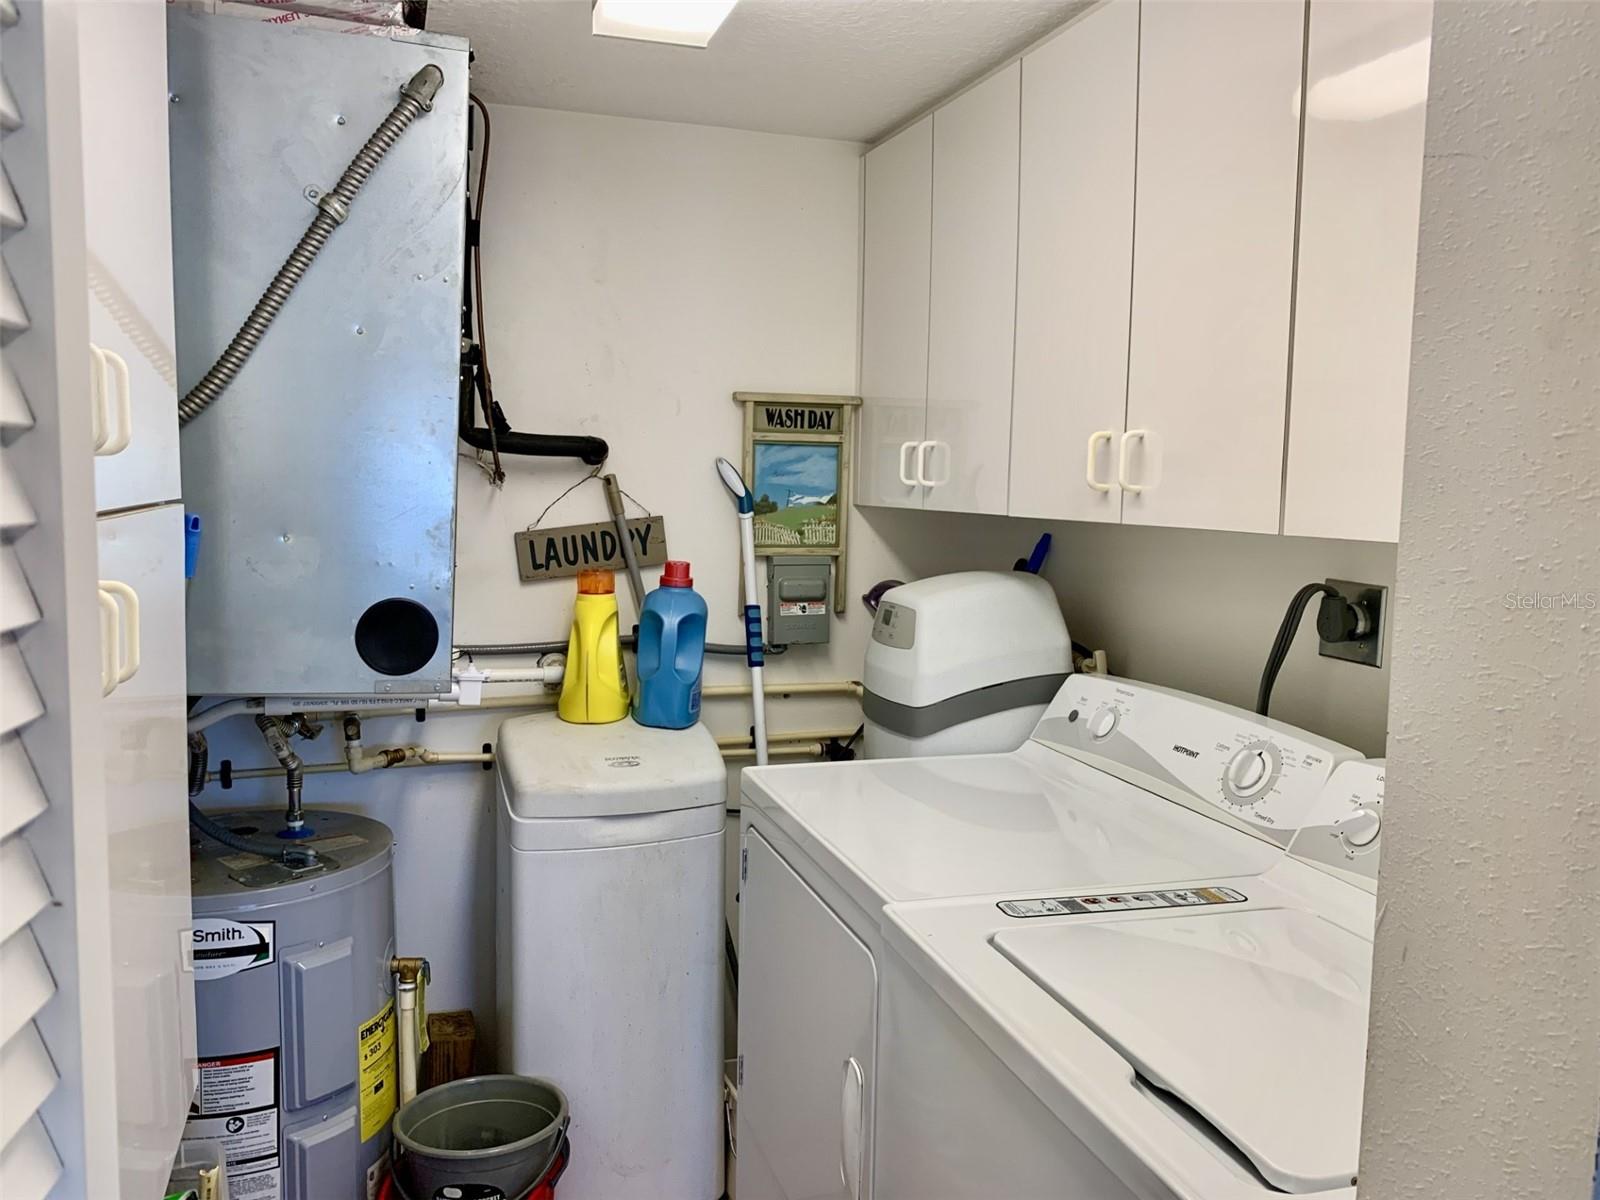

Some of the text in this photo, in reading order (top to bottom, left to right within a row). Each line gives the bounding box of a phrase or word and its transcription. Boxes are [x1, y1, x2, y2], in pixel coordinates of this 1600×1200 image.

[765, 407, 835, 430] WASH DAY
[1172, 743, 1200, 760] HOTPOINT
